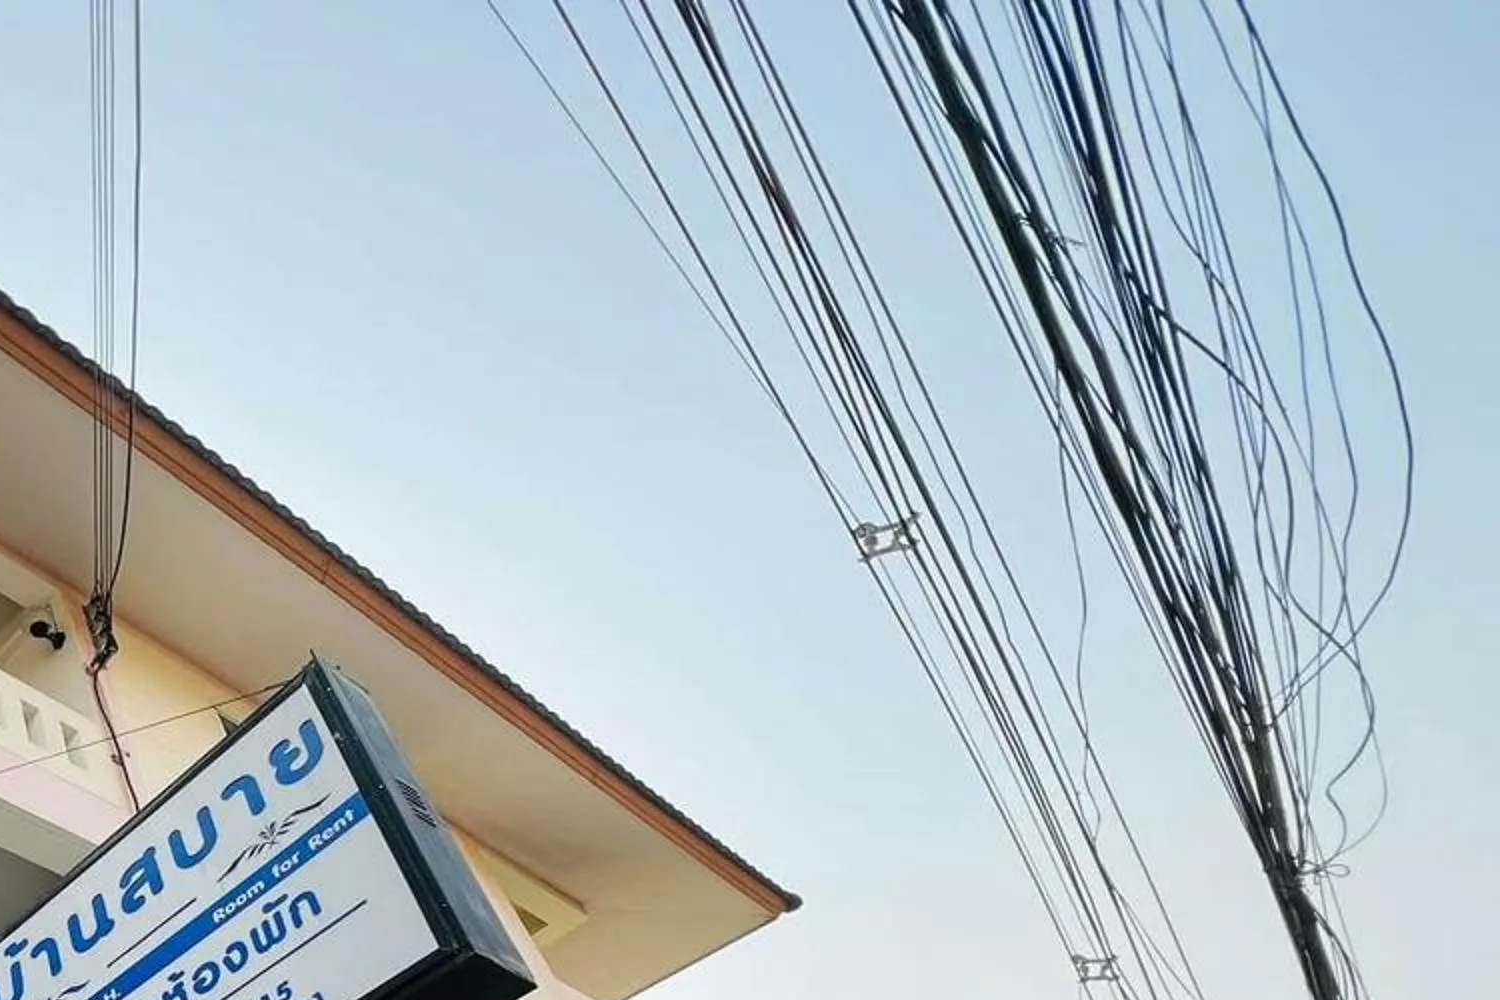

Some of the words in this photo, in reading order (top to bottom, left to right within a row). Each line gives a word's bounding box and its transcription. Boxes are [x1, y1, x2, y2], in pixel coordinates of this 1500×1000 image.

[212, 880, 266, 923] Room
[271, 853, 300, 878] for
[308, 809, 356, 849] Rent
